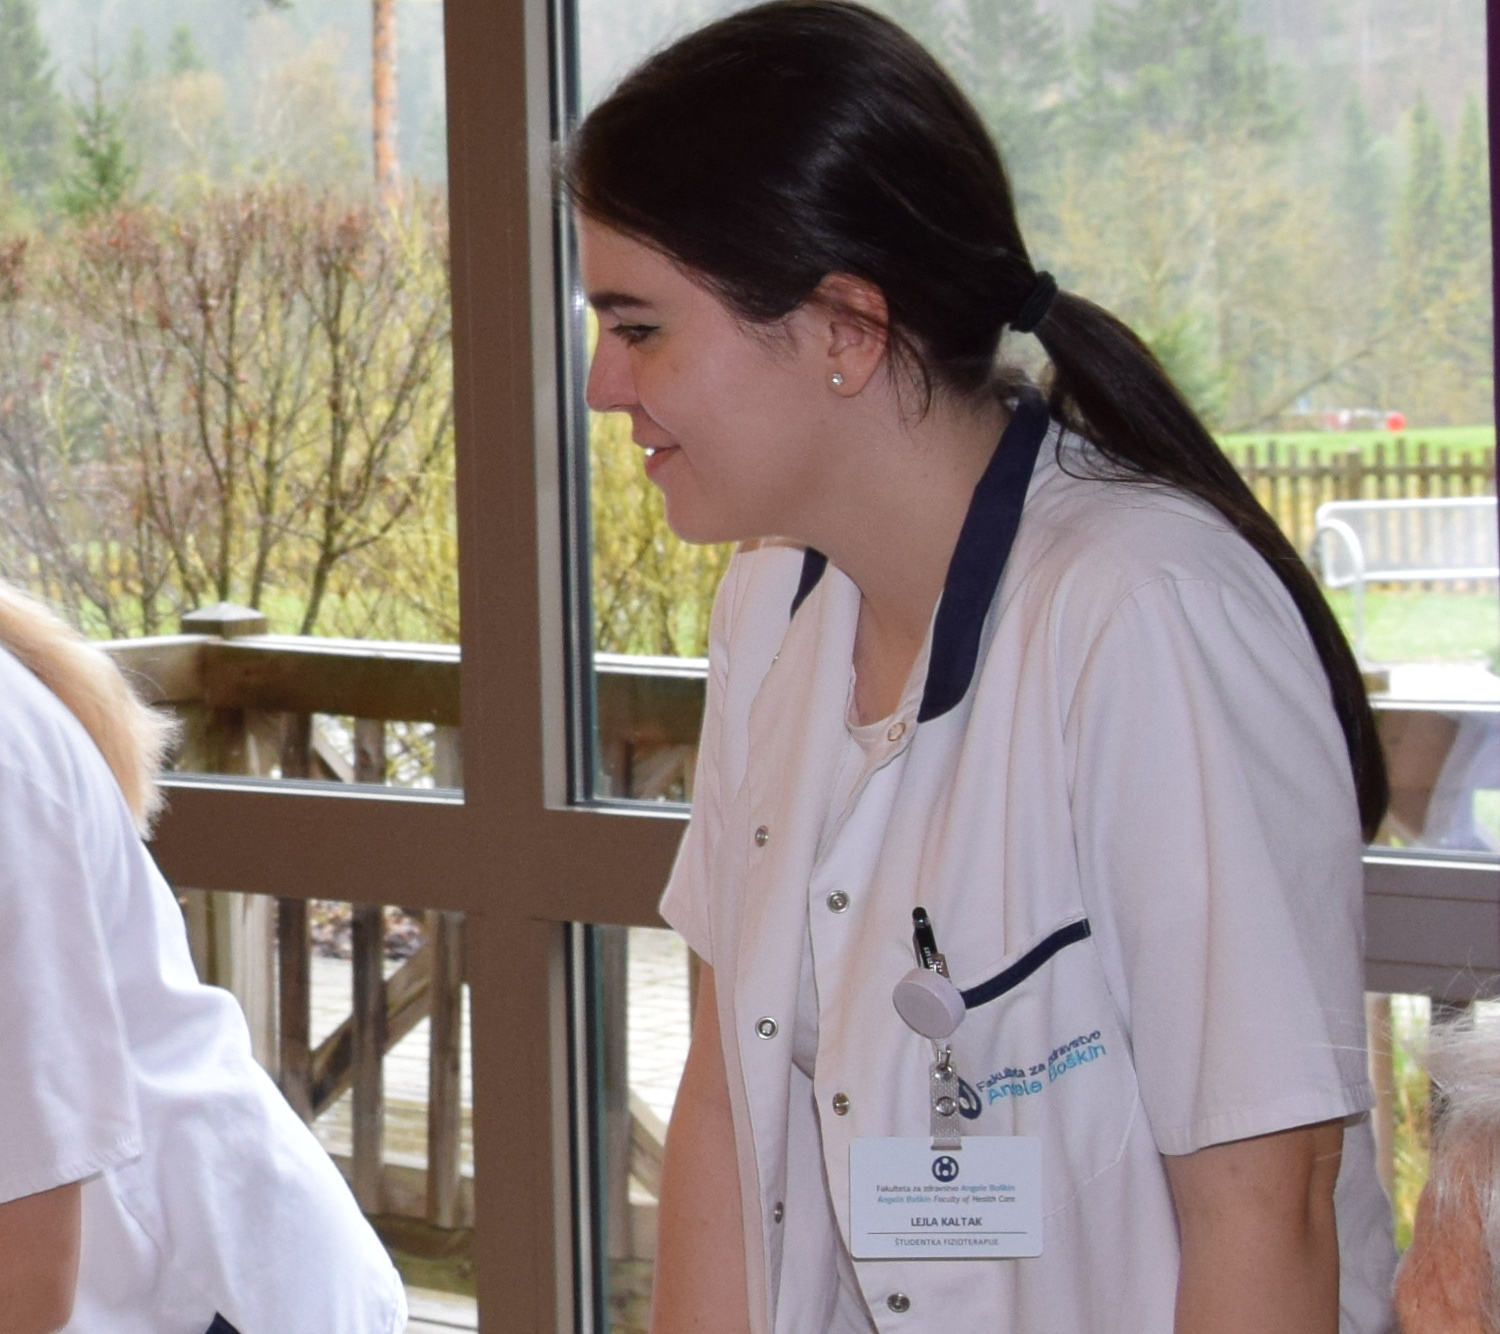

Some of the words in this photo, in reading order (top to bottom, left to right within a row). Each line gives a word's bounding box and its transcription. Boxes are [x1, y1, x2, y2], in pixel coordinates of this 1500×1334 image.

[876, 1184, 910, 1193] Fakulteta
[921, 1184, 960, 1193] zdravstvo
[933, 1195, 960, 1206] Faculty
[961, 1195, 971, 1206] of
[972, 1195, 997, 1204] Health
[997, 1195, 1016, 1204] Care
[910, 1216, 939, 1227] LEJLA
[941, 1216, 983, 1227] KALTAK
[895, 1237, 942, 1247] ŠTUDENTKA
